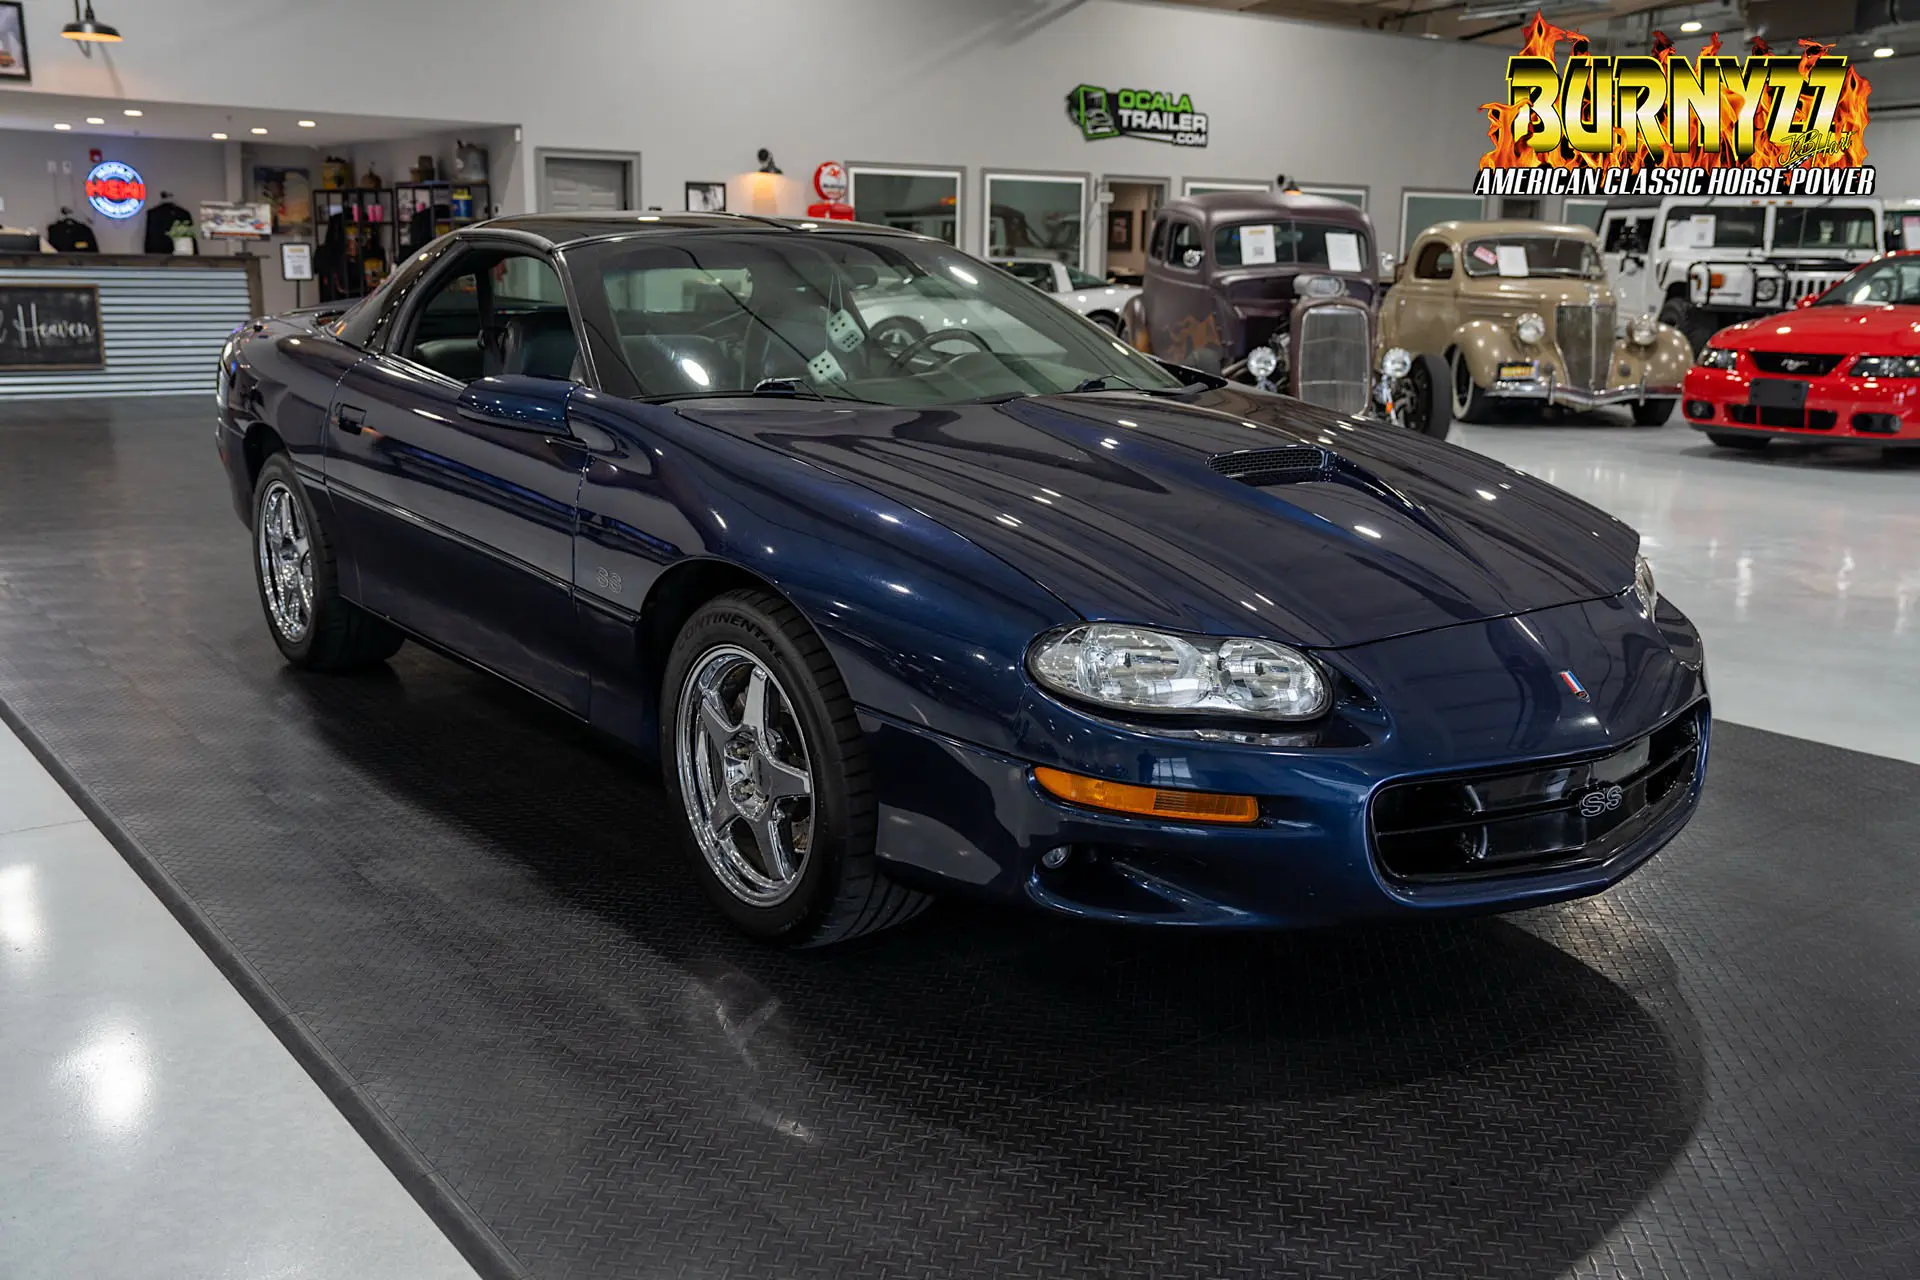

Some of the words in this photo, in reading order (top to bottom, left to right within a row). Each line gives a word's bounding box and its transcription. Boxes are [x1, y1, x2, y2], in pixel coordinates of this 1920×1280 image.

[1118, 89, 1193, 113] OCALA
[1118, 109, 1207, 132] TRAILER
[1173, 132, 1206, 145] .COM
[12, 302, 96, 348] Heaven
[1580, 785, 1623, 817] SS
